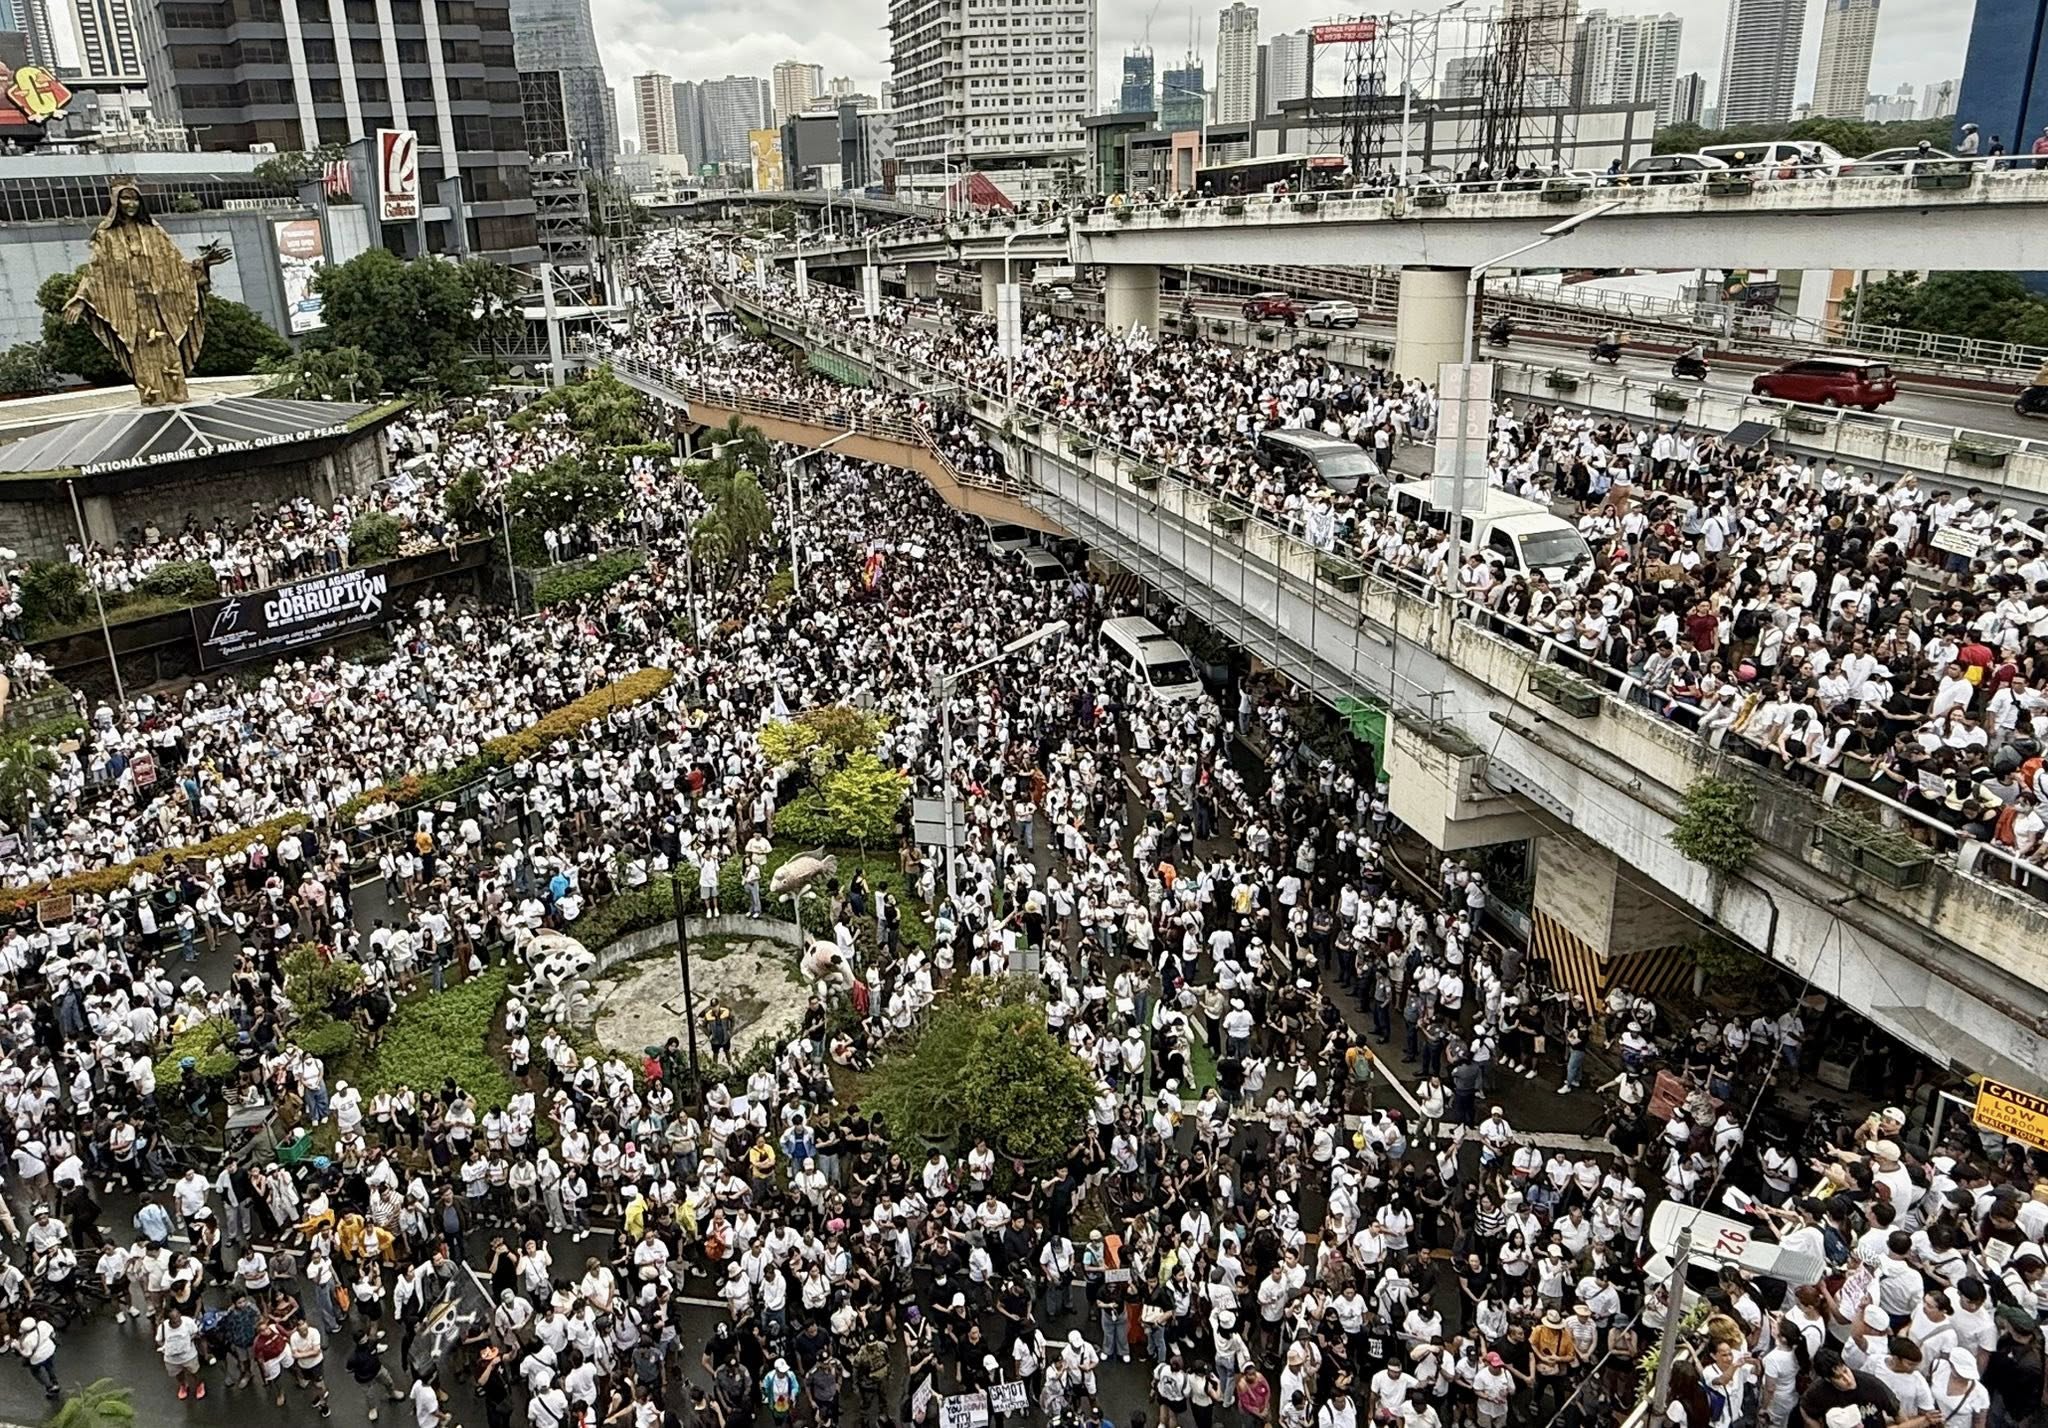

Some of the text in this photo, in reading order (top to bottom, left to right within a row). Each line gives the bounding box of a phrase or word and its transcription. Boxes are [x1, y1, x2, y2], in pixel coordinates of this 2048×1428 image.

[81, 424, 349, 476] NATIONAL SHRINE OF MARY, QUEEN OF PEACE
[278, 569, 366, 599] WE STAND AGAINST
[1989, 1085, 2048, 1114] CAUTI
[1994, 1101, 2036, 1122] LOW
[1981, 1114, 2012, 1133] WATCH
[2015, 1129, 2041, 1144] YOUR
[1982, 1106, 2045, 1136] HEADROOM
[990, 1382, 1025, 1401] GAMOT
[945, 1403, 962, 1414] YOU
[948, 1412, 971, 1424] WITH
